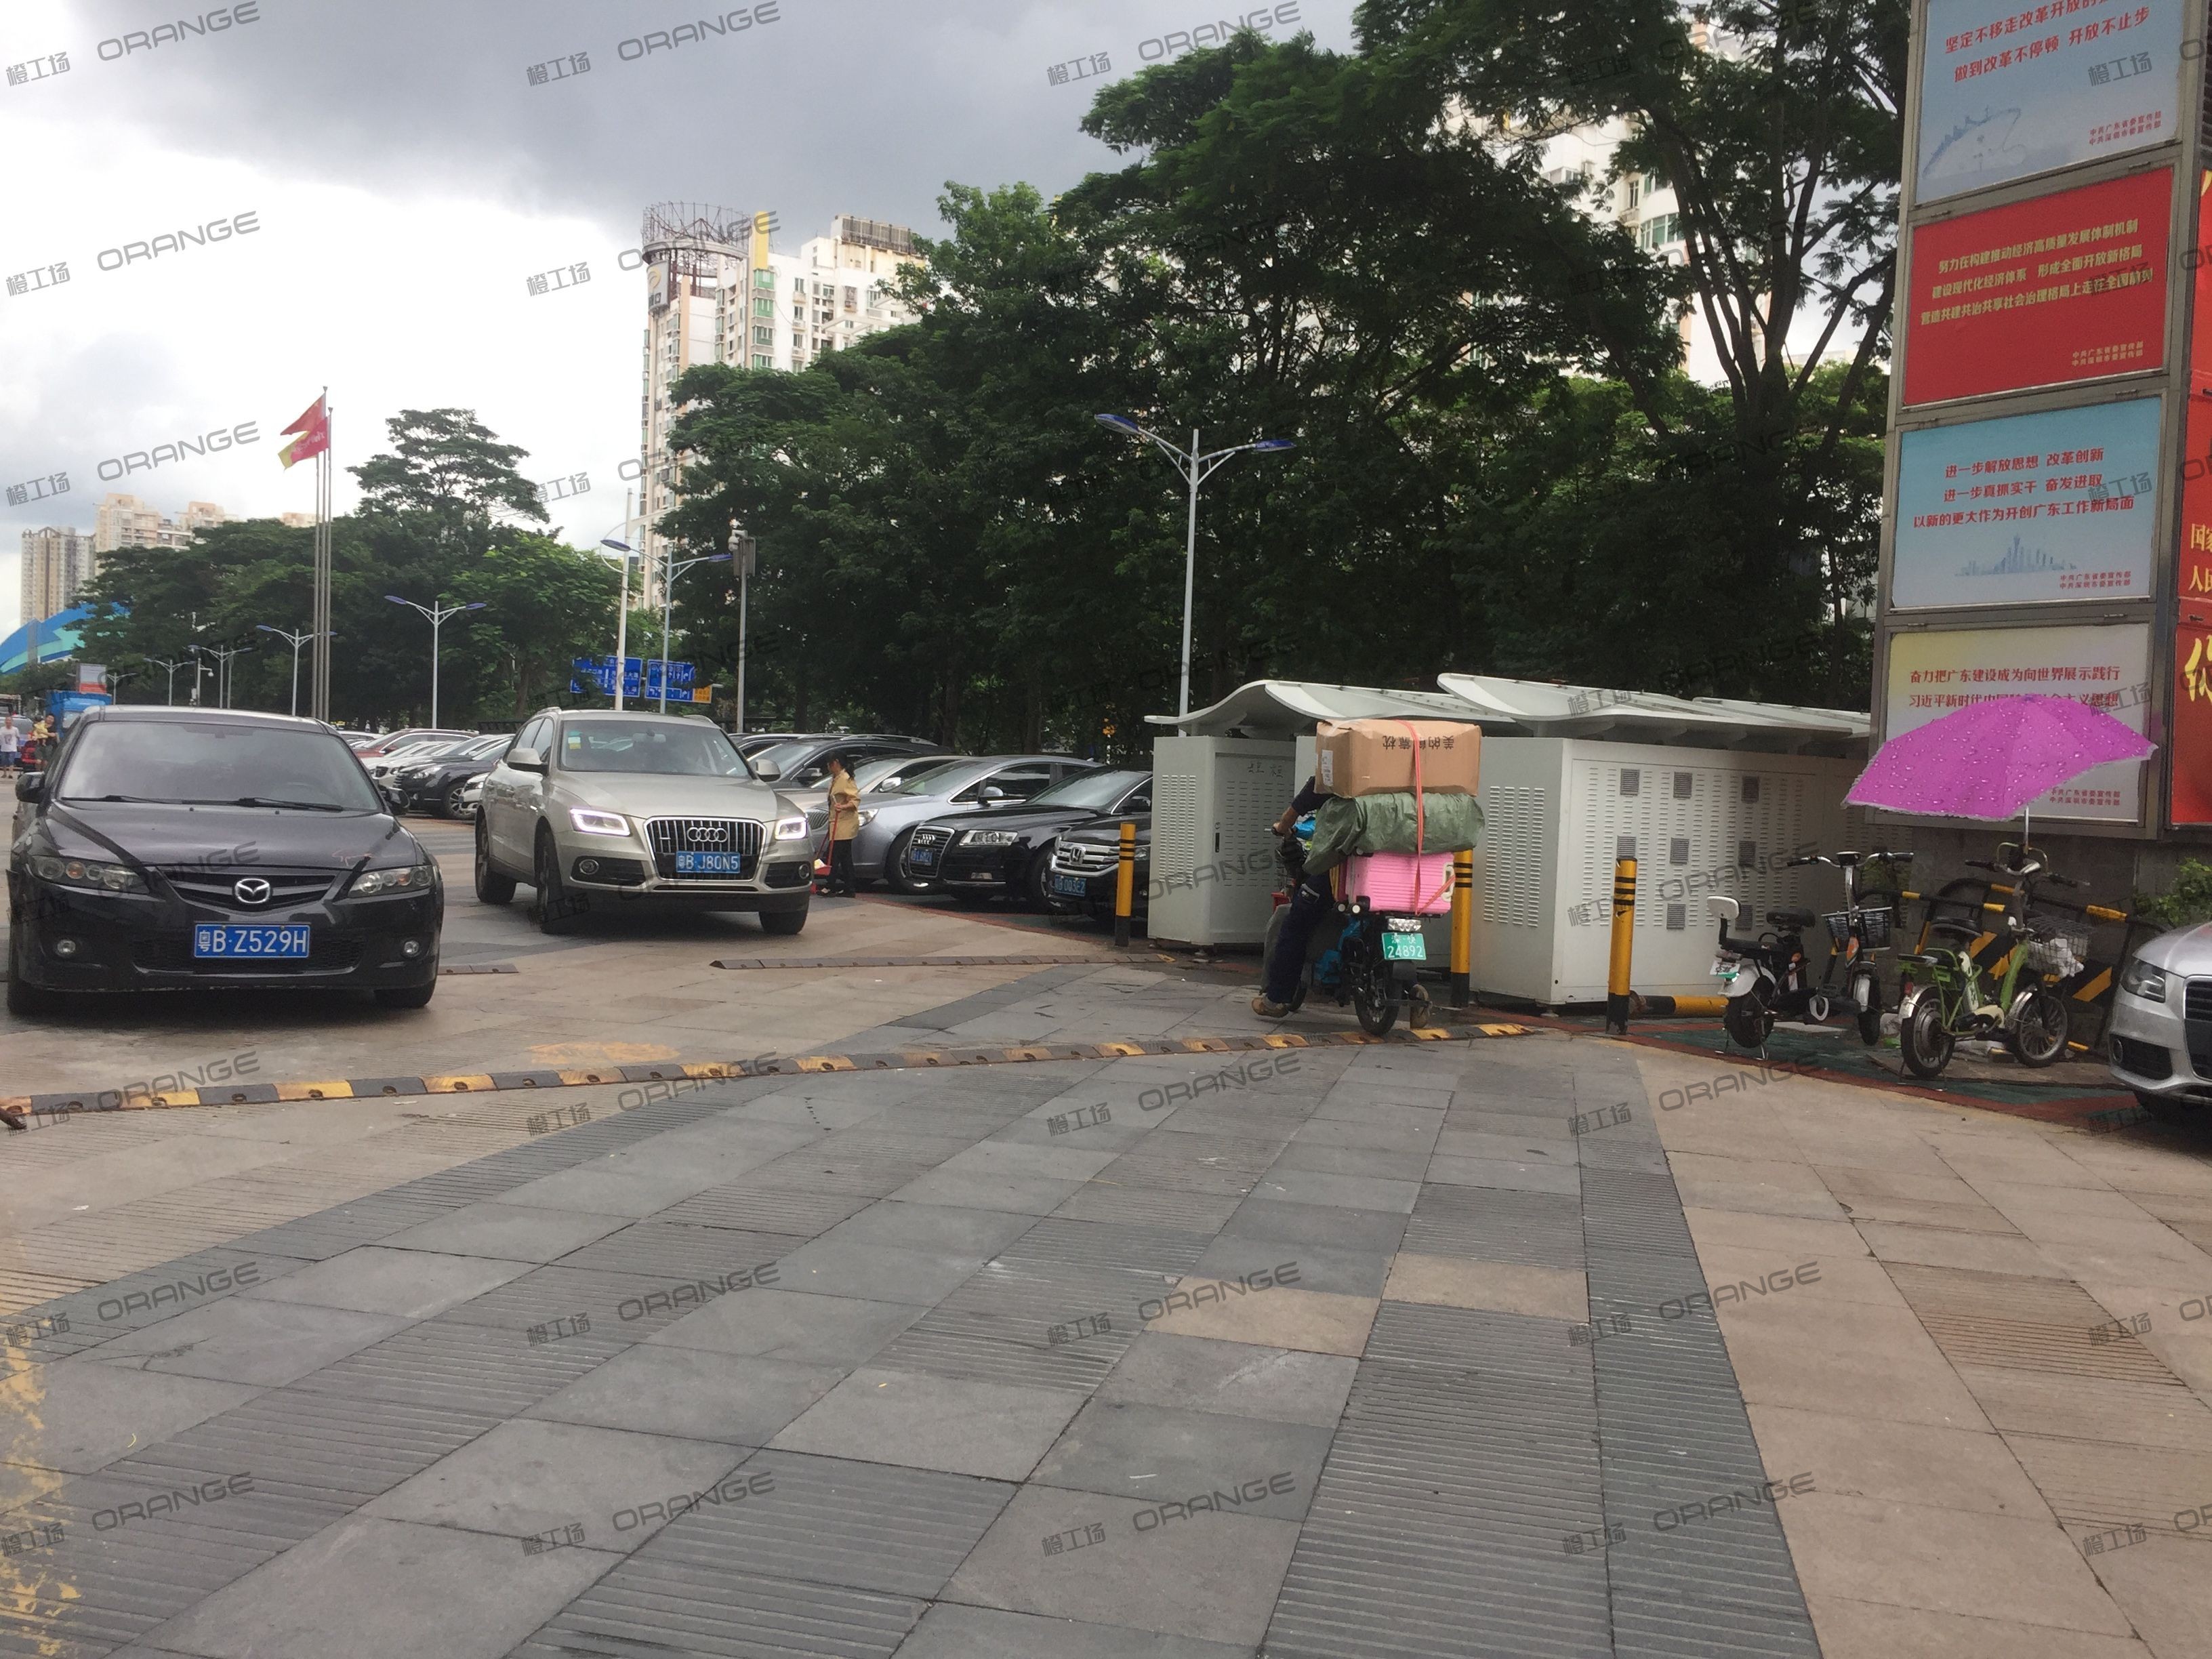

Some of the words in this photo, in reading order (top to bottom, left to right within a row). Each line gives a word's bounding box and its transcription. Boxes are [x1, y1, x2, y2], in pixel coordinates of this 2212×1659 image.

[1954, 35, 2060, 82] 做到改革不停顿
[2068, 6, 2150, 46] 开放不止步
[1932, 268, 2027, 299] 建设现代化经济体系
[2038, 244, 2142, 277] 形成全面开放新格局
[1945, 455, 2039, 478] 进一步解放思想
[2046, 448, 2104, 466] 改革创新
[1943, 480, 2037, 502] 进一步真抓实干
[2045, 474, 2103, 492] 奋发进取
[1914, 495, 2135, 528] 以新的更大作为开创广东工作新局面
[1910, 666, 2120, 683] 奋力把广东建设成为向世界展示践行
[198, 930, 306, 953] 粤B·Z529H
[1387, 945, 1423, 958] 24892
